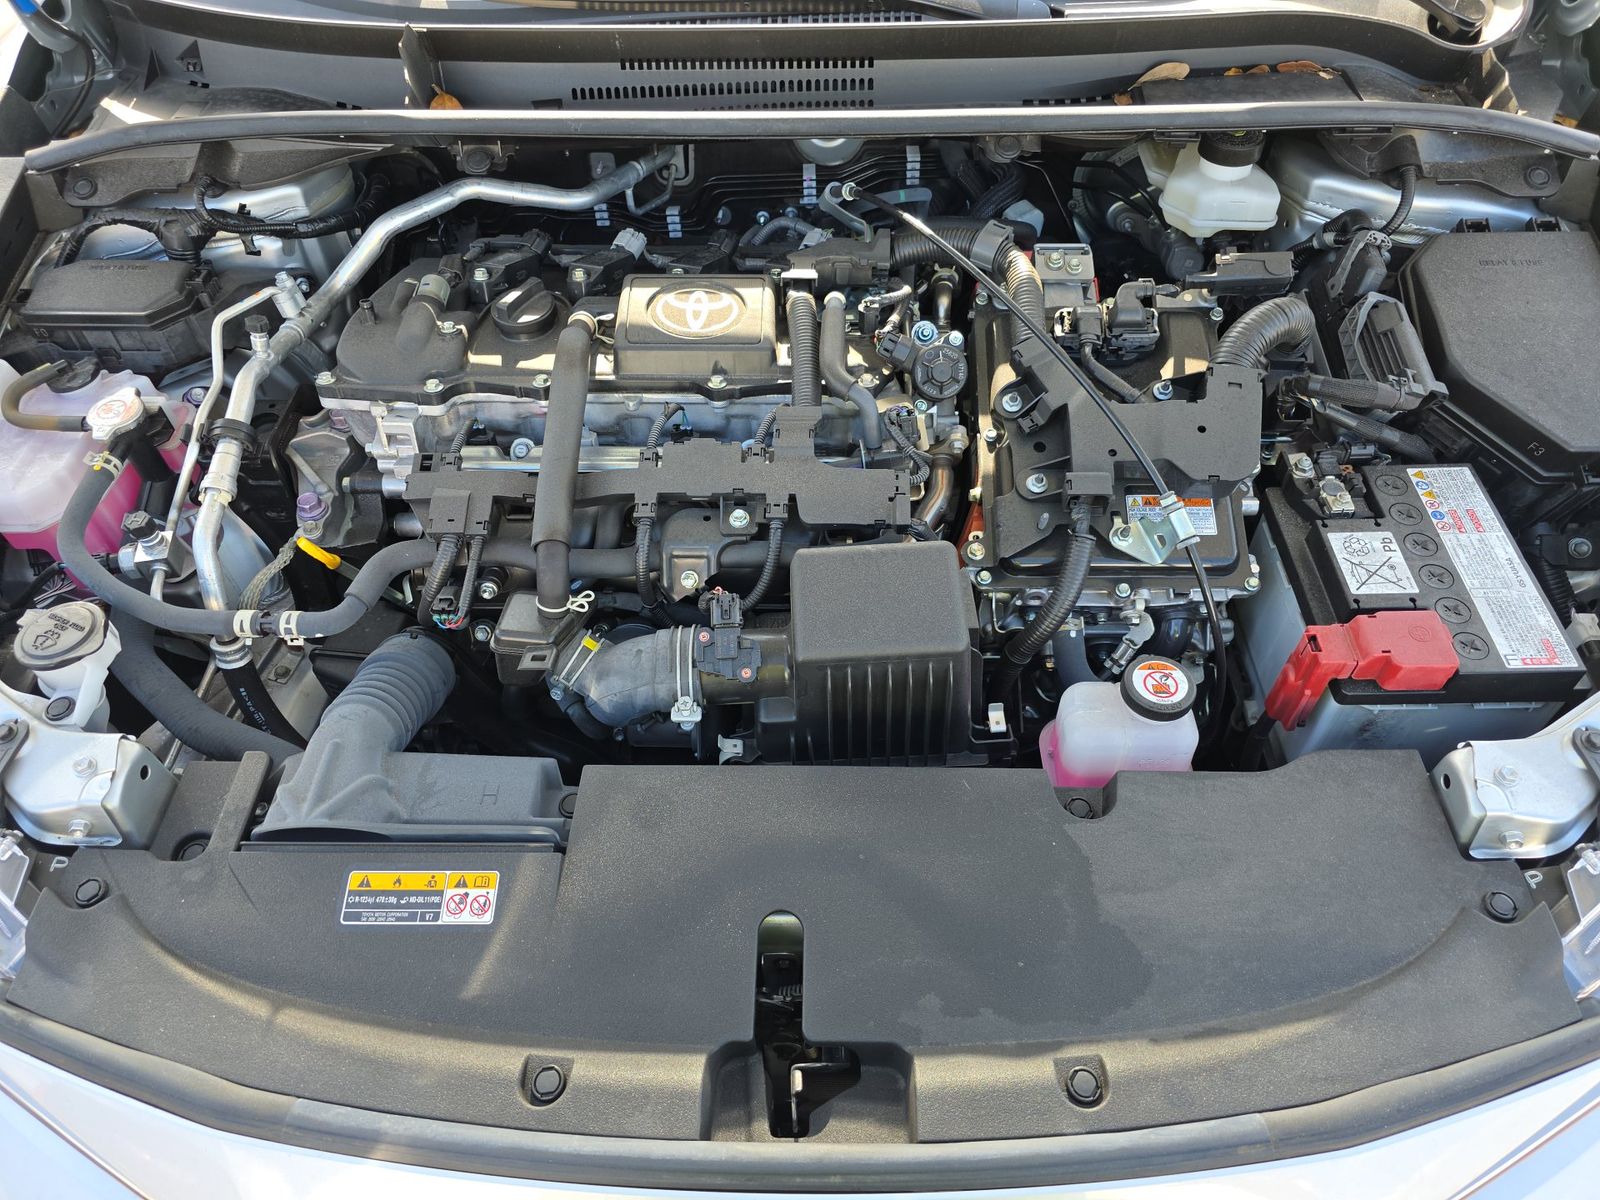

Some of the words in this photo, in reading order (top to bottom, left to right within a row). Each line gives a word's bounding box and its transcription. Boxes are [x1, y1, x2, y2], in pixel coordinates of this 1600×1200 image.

[1527, 441, 1545, 456] F3
[1380, 537, 1397, 552] Pb
[425, 913, 434, 921] V7
